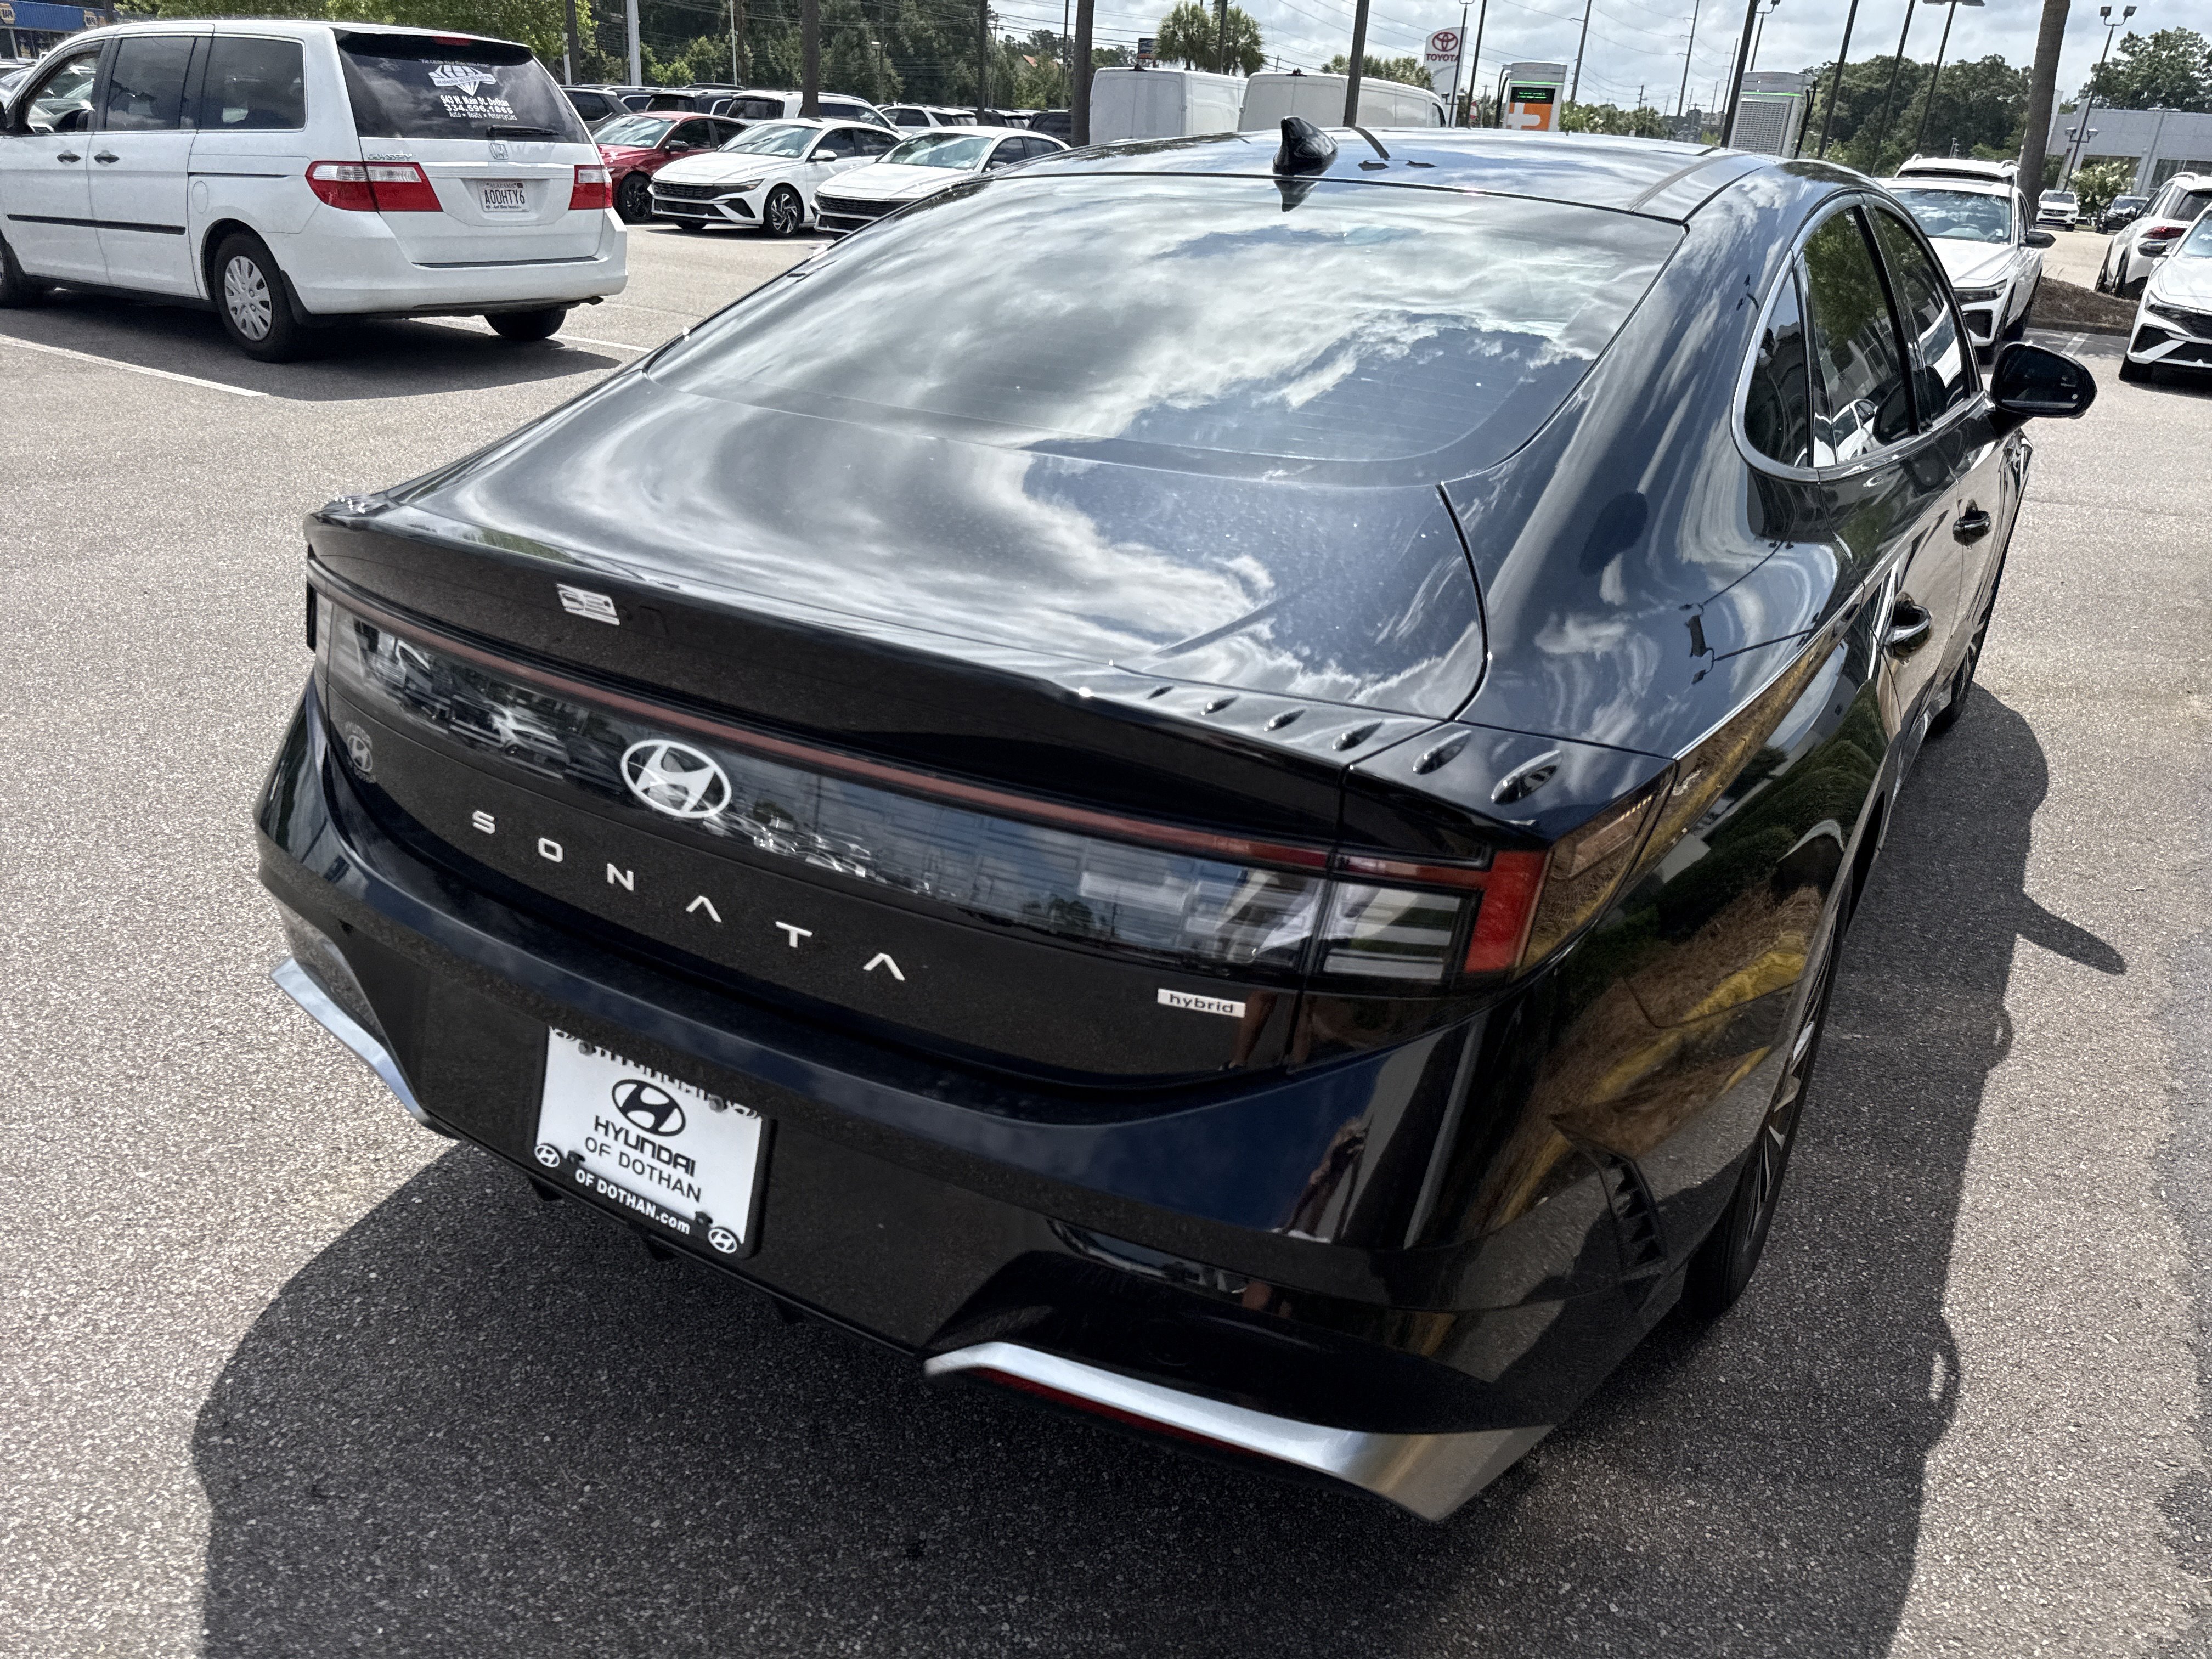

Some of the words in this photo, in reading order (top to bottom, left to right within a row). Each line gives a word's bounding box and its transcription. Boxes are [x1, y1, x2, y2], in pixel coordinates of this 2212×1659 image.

[440, 95, 454, 104] 943
[453, 95, 463, 104] W.
[462, 96, 479, 105] Main
[477, 97, 488, 105] St.
[487, 97, 510, 106] Dothan
[487, 112, 517, 121] Motorcycles
[471, 810, 905, 981] SONATA
[1170, 994, 1233, 1013] hybrid
[585, 1136, 611, 1157] OF
[618, 1150, 702, 1203] DOTHAN
[594, 1115, 696, 1177] HYUNDAI
[575, 1169, 595, 1187] OF
[596, 1178, 691, 1235] DOTHAN.com
